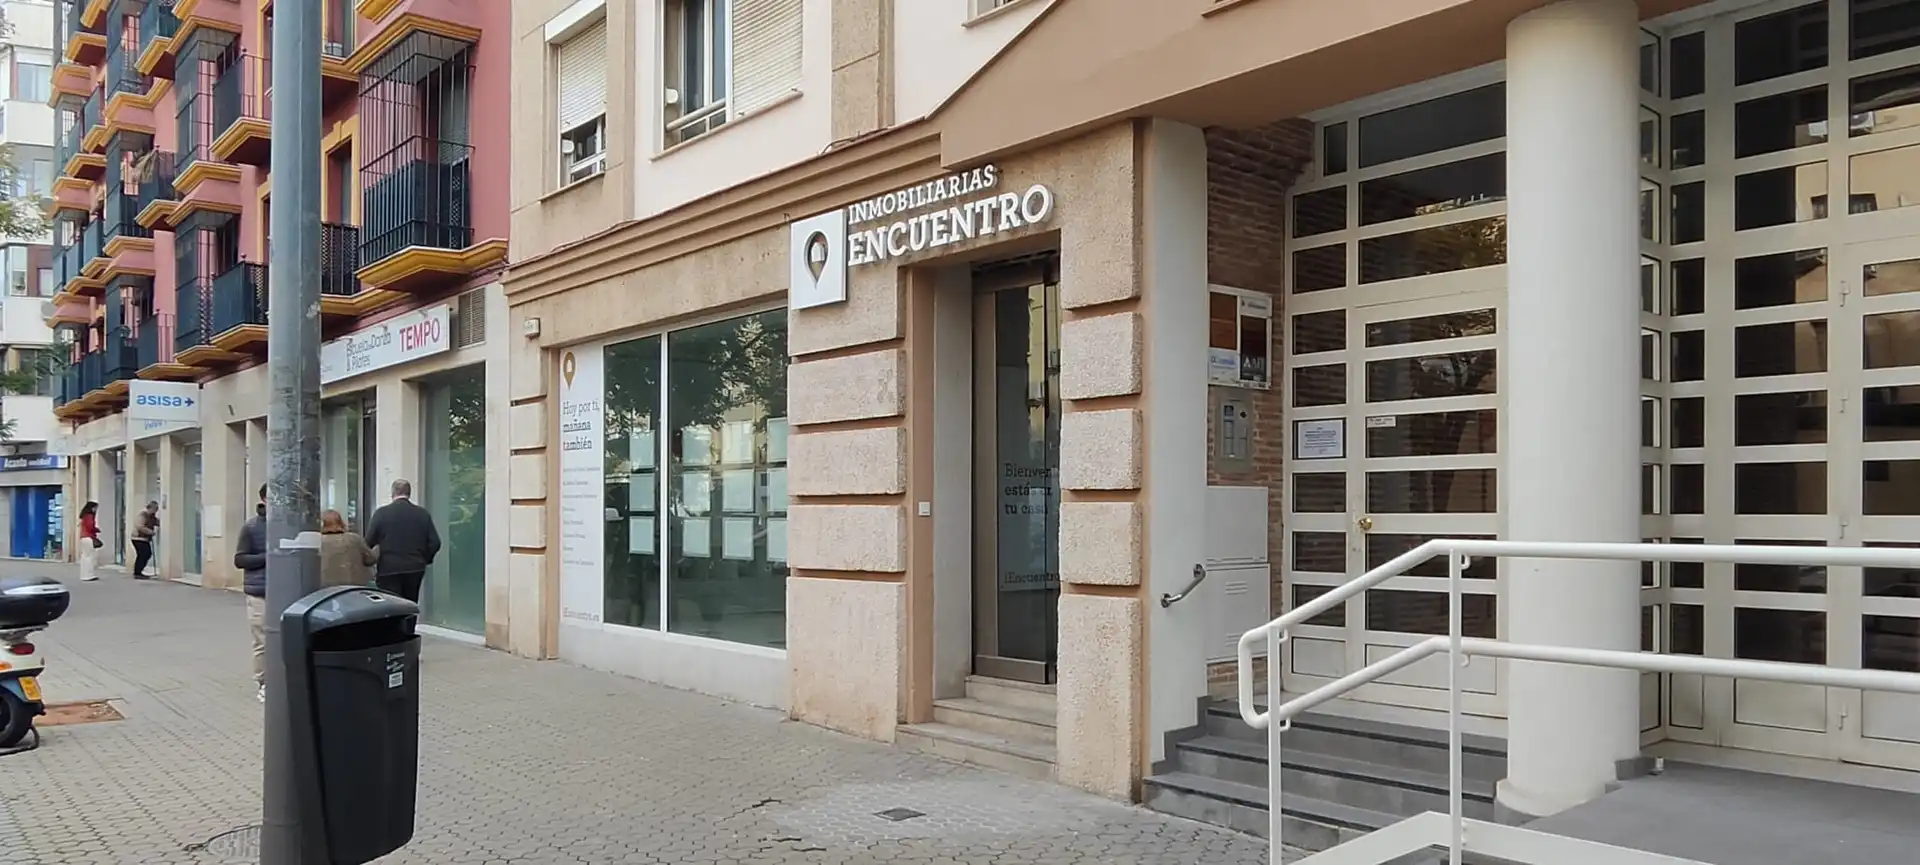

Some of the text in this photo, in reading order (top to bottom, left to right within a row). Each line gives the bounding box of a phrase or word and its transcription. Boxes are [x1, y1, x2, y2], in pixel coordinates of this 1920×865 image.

[848, 164, 997, 225] INMOBILIARIAS
[848, 184, 1054, 266] ENCUENTRO
[399, 318, 441, 352] TEMPO
[136, 395, 182, 407] asisa
[563, 401, 577, 416] Hoy
[579, 402, 591, 416] por
[563, 419, 592, 432] mañana
[563, 436, 593, 450] también
[1004, 482, 1037, 496] estás
[1004, 503, 1017, 515] tu
